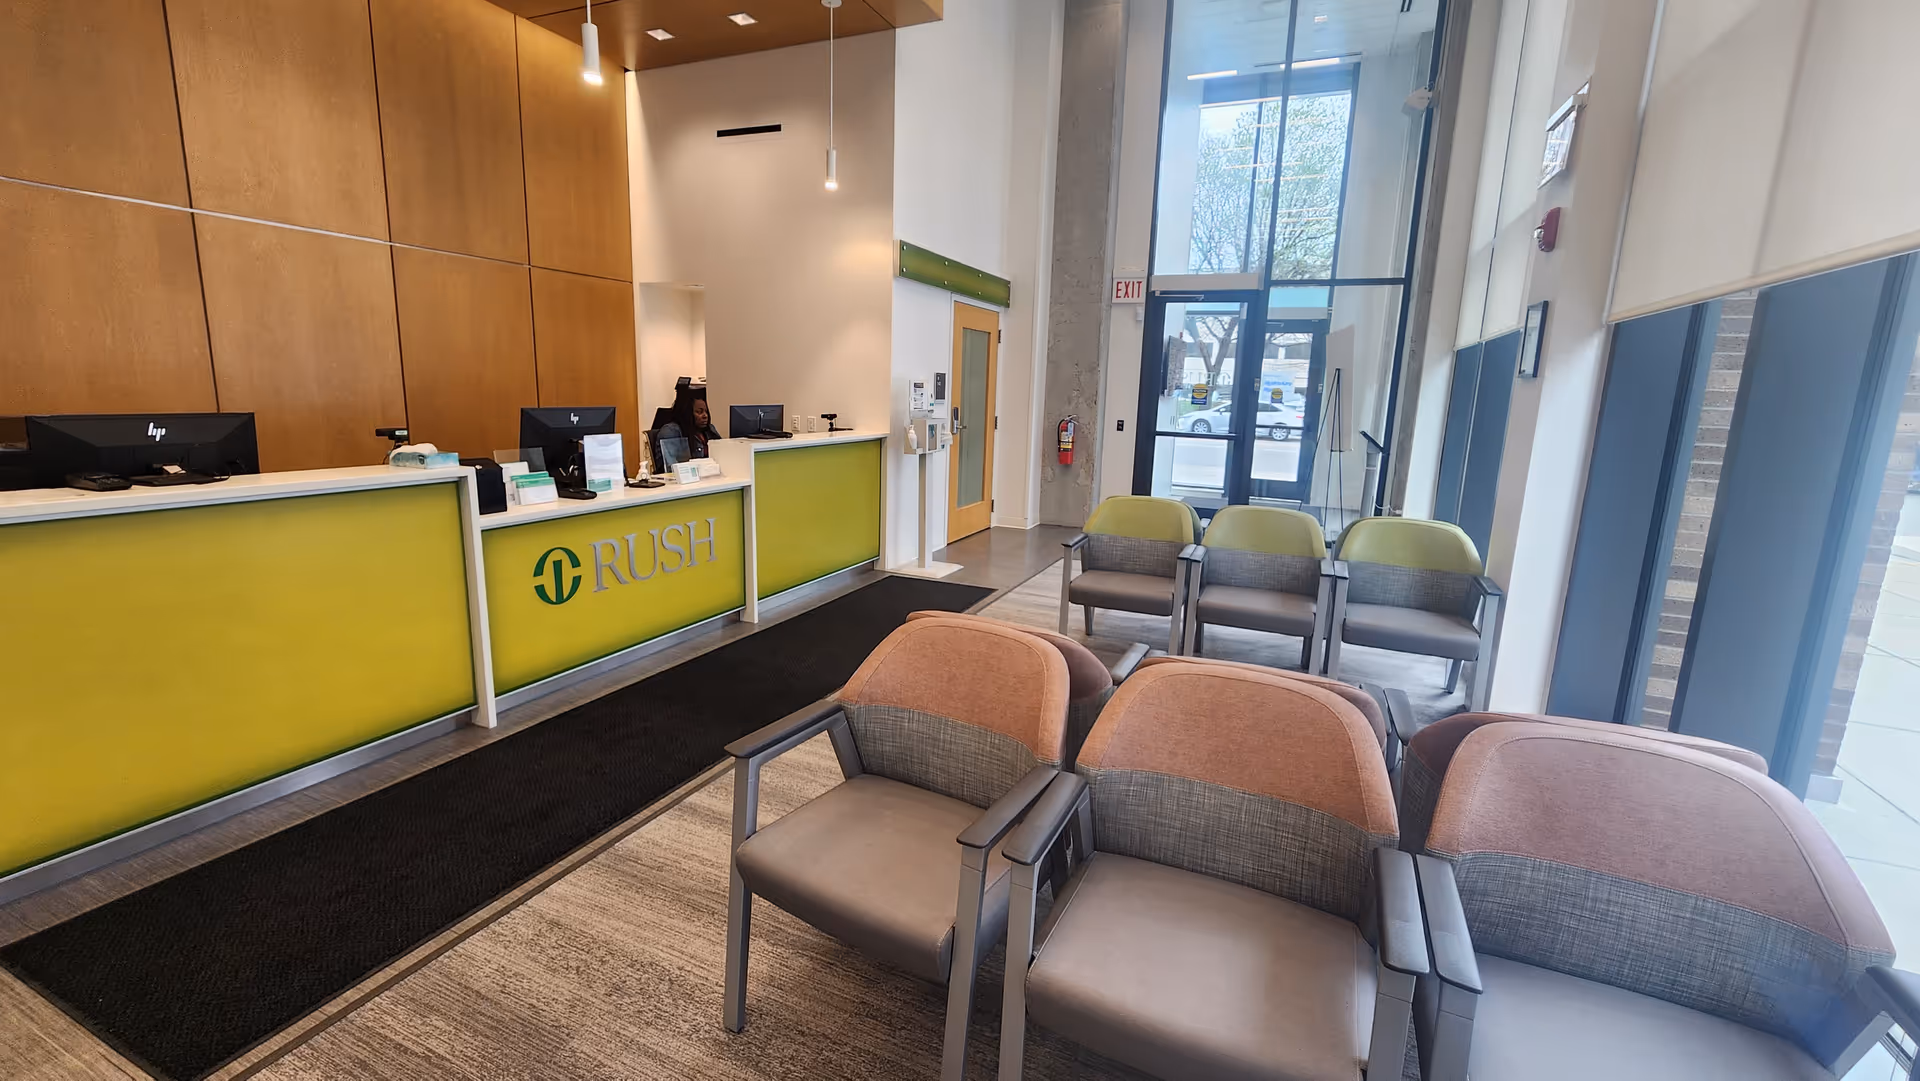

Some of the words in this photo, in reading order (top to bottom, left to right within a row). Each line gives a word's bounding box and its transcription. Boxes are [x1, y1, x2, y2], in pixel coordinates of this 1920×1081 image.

[1115, 281, 1142, 299] EXIT
[570, 412, 579, 425] hp
[147, 422, 166, 441] hp
[589, 517, 718, 593] RUSH
